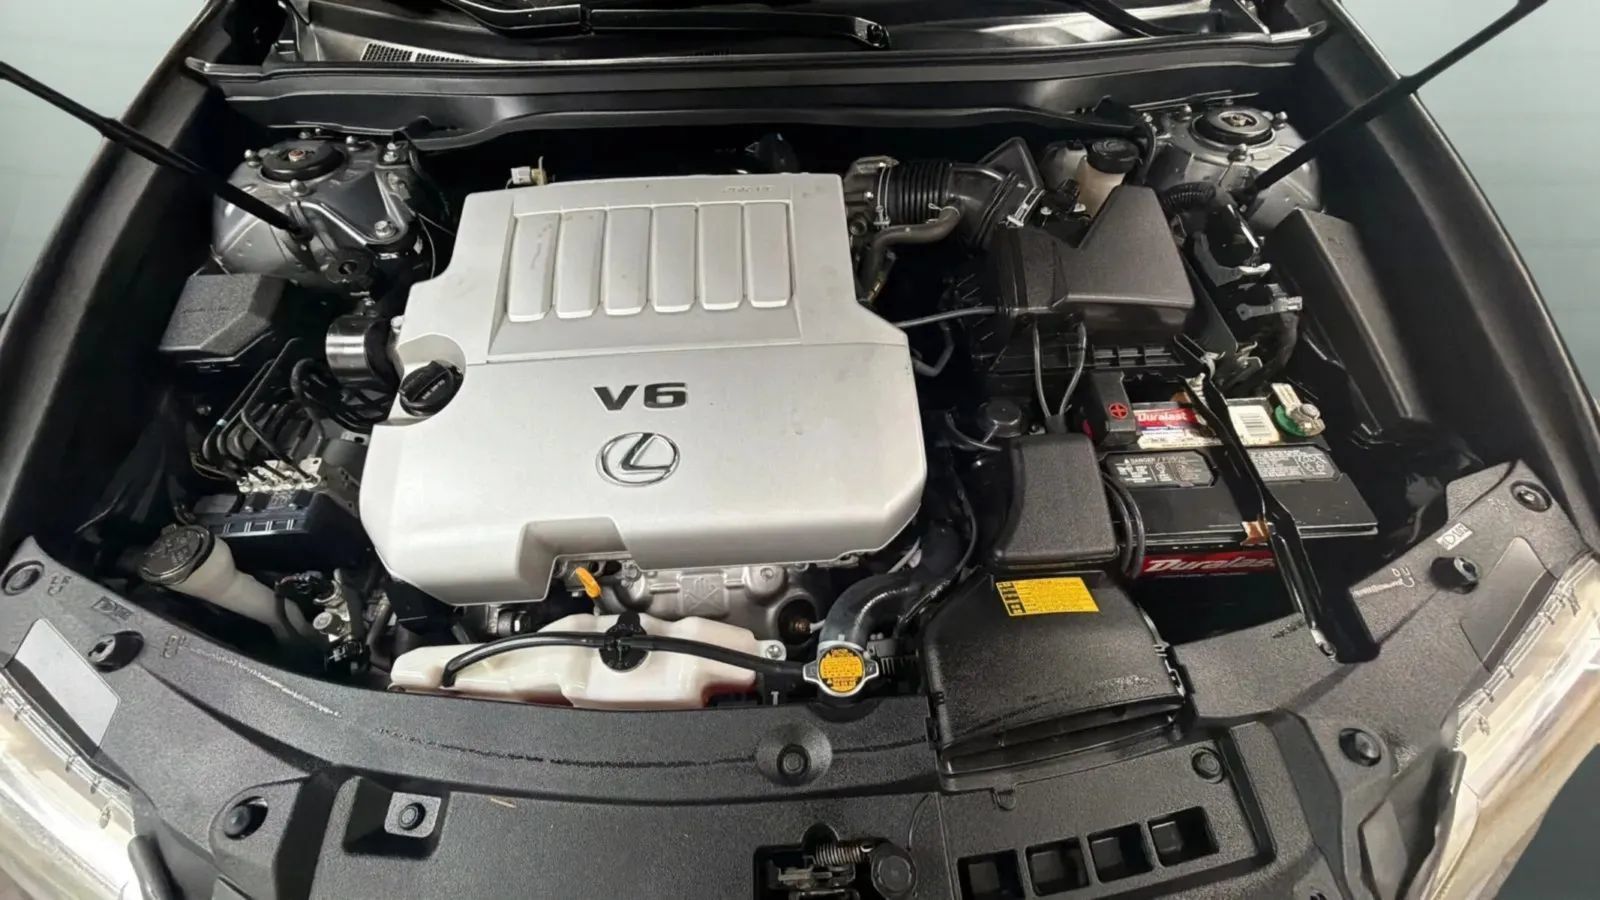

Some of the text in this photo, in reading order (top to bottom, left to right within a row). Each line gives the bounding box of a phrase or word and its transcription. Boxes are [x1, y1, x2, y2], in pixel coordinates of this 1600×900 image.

[594, 382, 687, 411] V6
[1138, 411, 1188, 422] Duralast
[1145, 556, 1275, 572] Duralas
